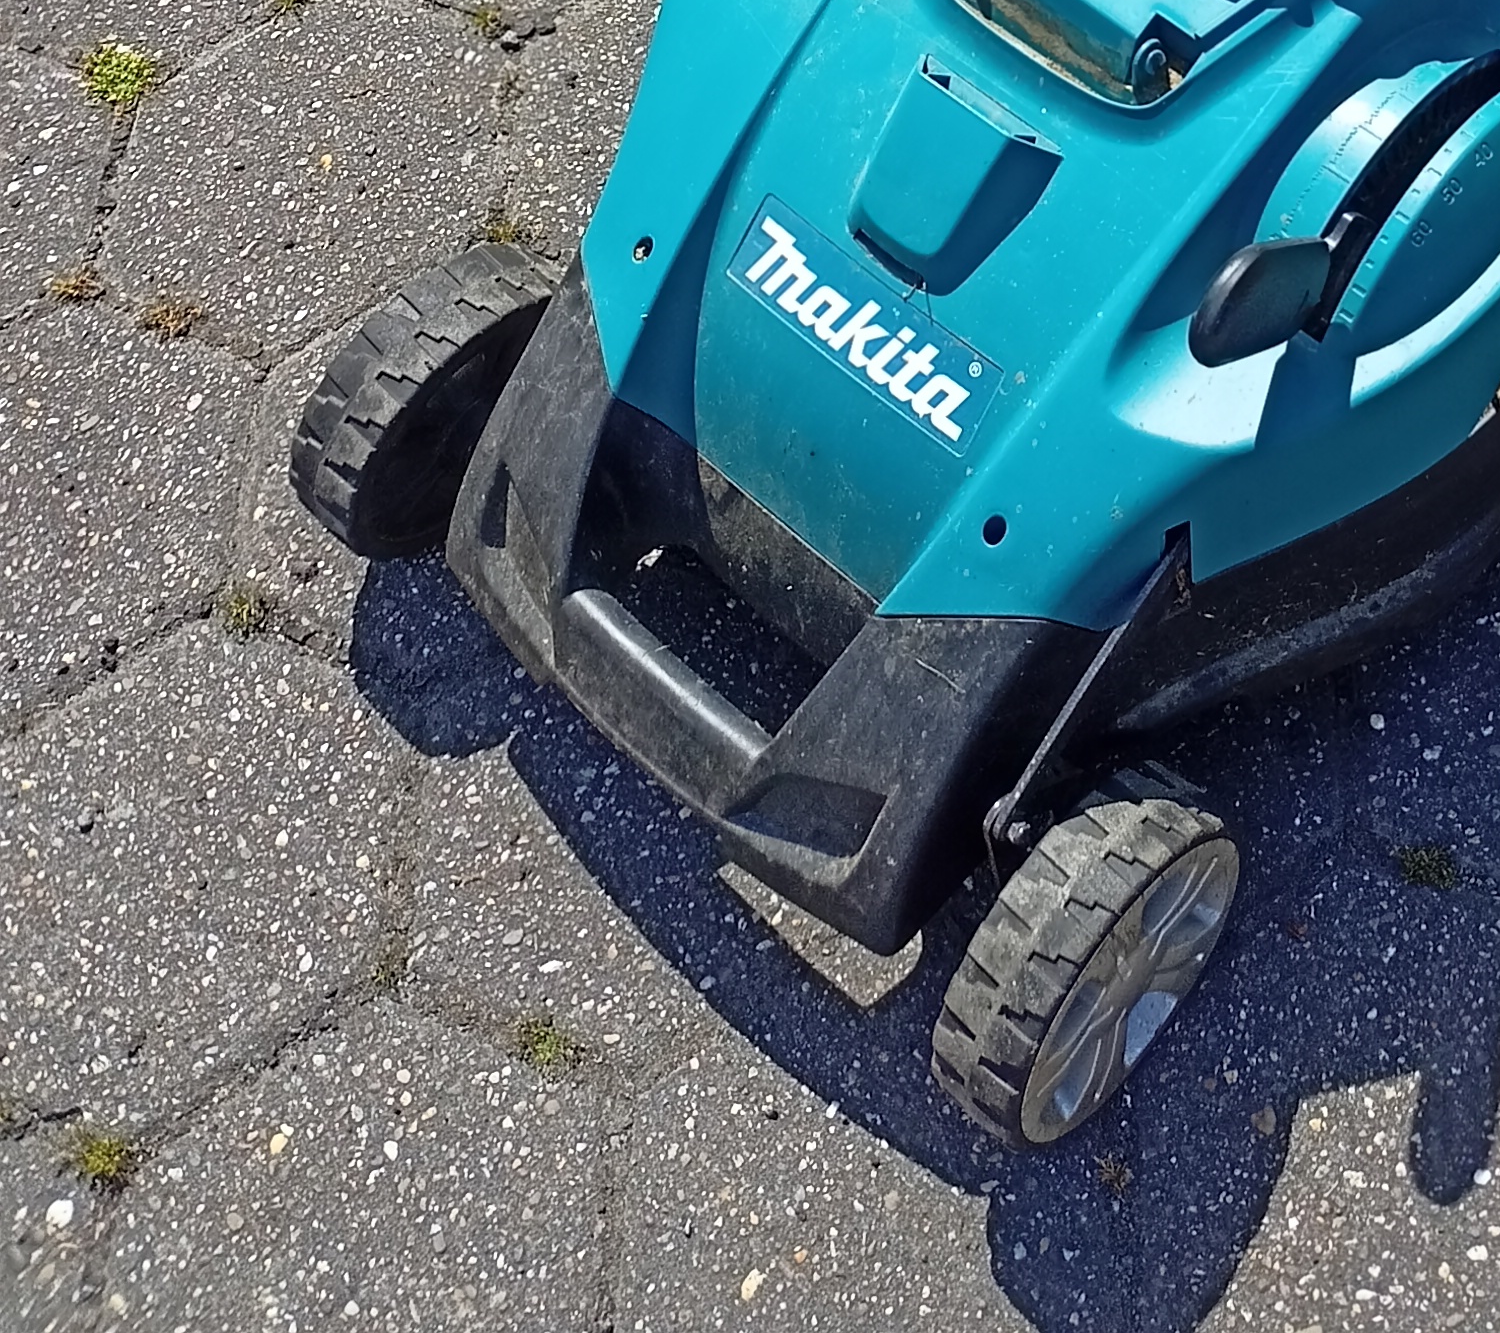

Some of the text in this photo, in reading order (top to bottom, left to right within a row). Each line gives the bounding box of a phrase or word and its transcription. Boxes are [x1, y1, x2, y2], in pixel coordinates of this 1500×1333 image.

[1475, 142, 1494, 167] 40
[1441, 178, 1463, 205] 50
[1411, 220, 1433, 248] 60
[744, 215, 971, 442] Makita
